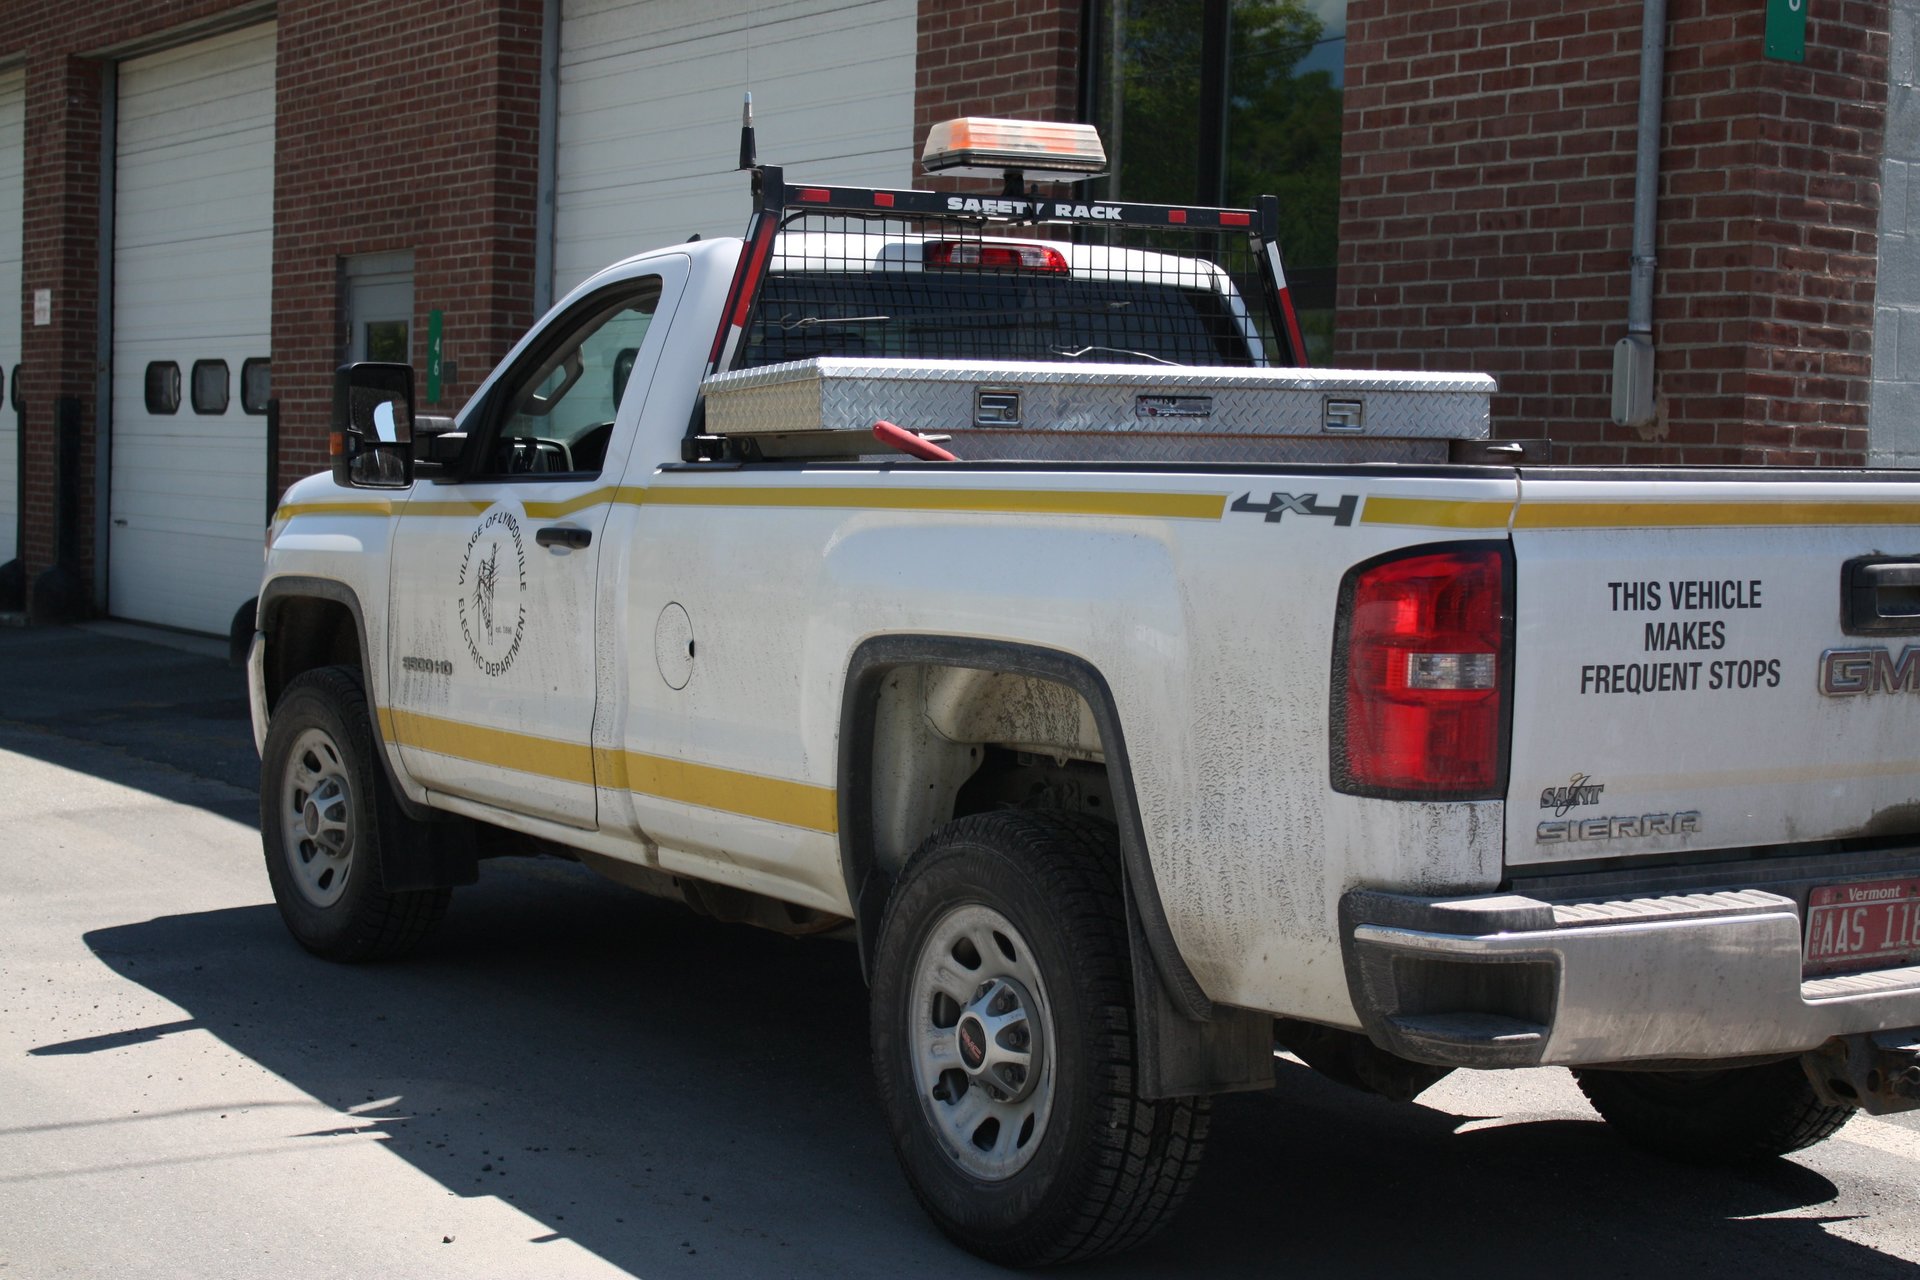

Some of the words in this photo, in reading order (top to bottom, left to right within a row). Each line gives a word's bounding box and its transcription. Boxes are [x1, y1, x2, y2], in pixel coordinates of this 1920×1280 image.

[947, 197, 1044, 215] SAFETY
[1055, 203, 1122, 220] RACK
[458, 523, 484, 586] VILLAGE
[485, 512, 498, 528] OF
[498, 511, 527, 592] LYNDONVILLE
[1608, 581, 1661, 611] THIS
[1669, 580, 1762, 610] VEHICLE
[458, 598, 484, 670] ELECTRIC
[486, 603, 527, 677] DEPARTMENT
[1644, 620, 1725, 651] MAKES
[1580, 661, 1703, 695] FREQUENT
[1709, 659, 1781, 690] STOPS
[1536, 810, 1702, 845] SIERRA
[1848, 885, 1901, 901] Vermont
[1820, 907, 1868, 955] AAS
